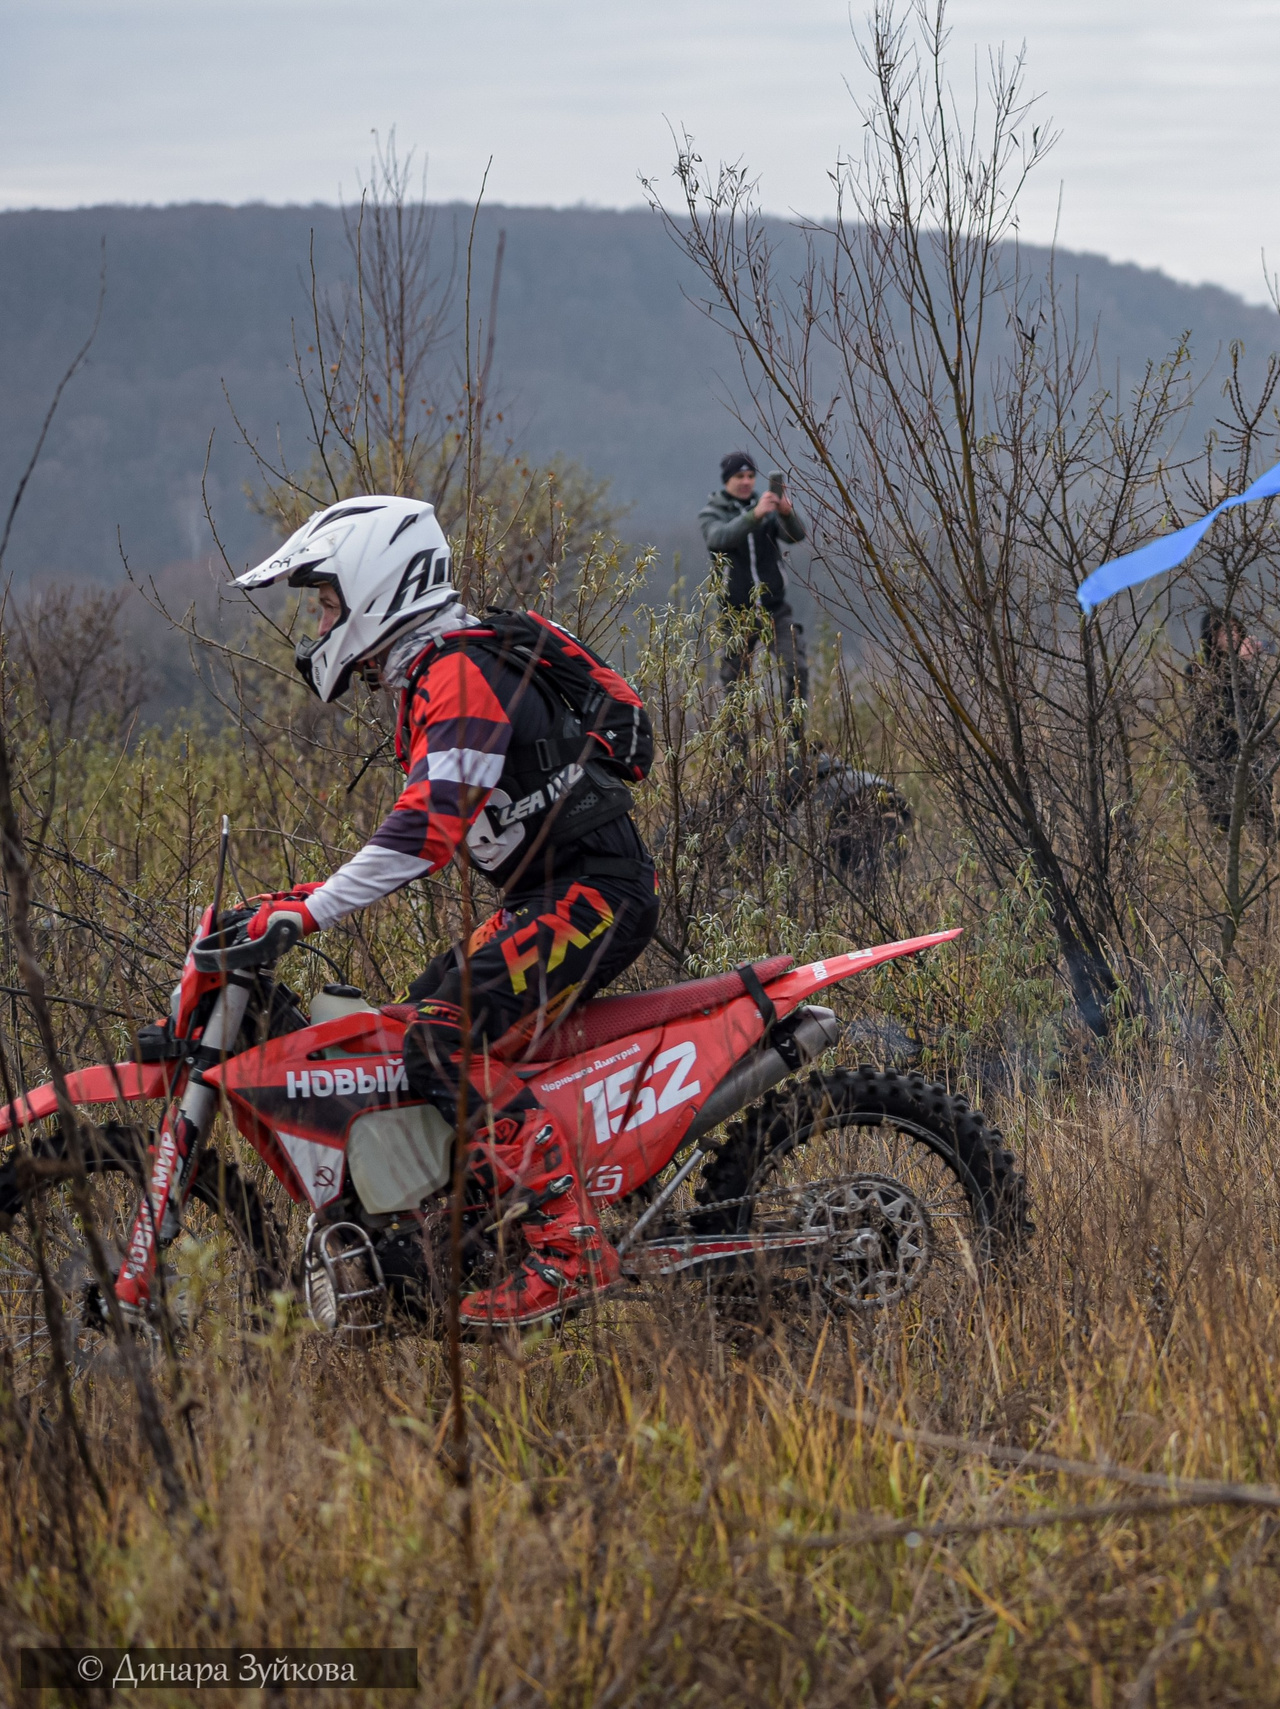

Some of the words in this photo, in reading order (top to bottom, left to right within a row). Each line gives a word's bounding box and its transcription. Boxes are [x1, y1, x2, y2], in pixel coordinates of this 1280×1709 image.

[286, 1058, 409, 1098] НОВЫЙ
[584, 1041, 701, 1144] 152
[152, 1131, 176, 1188] МИР
